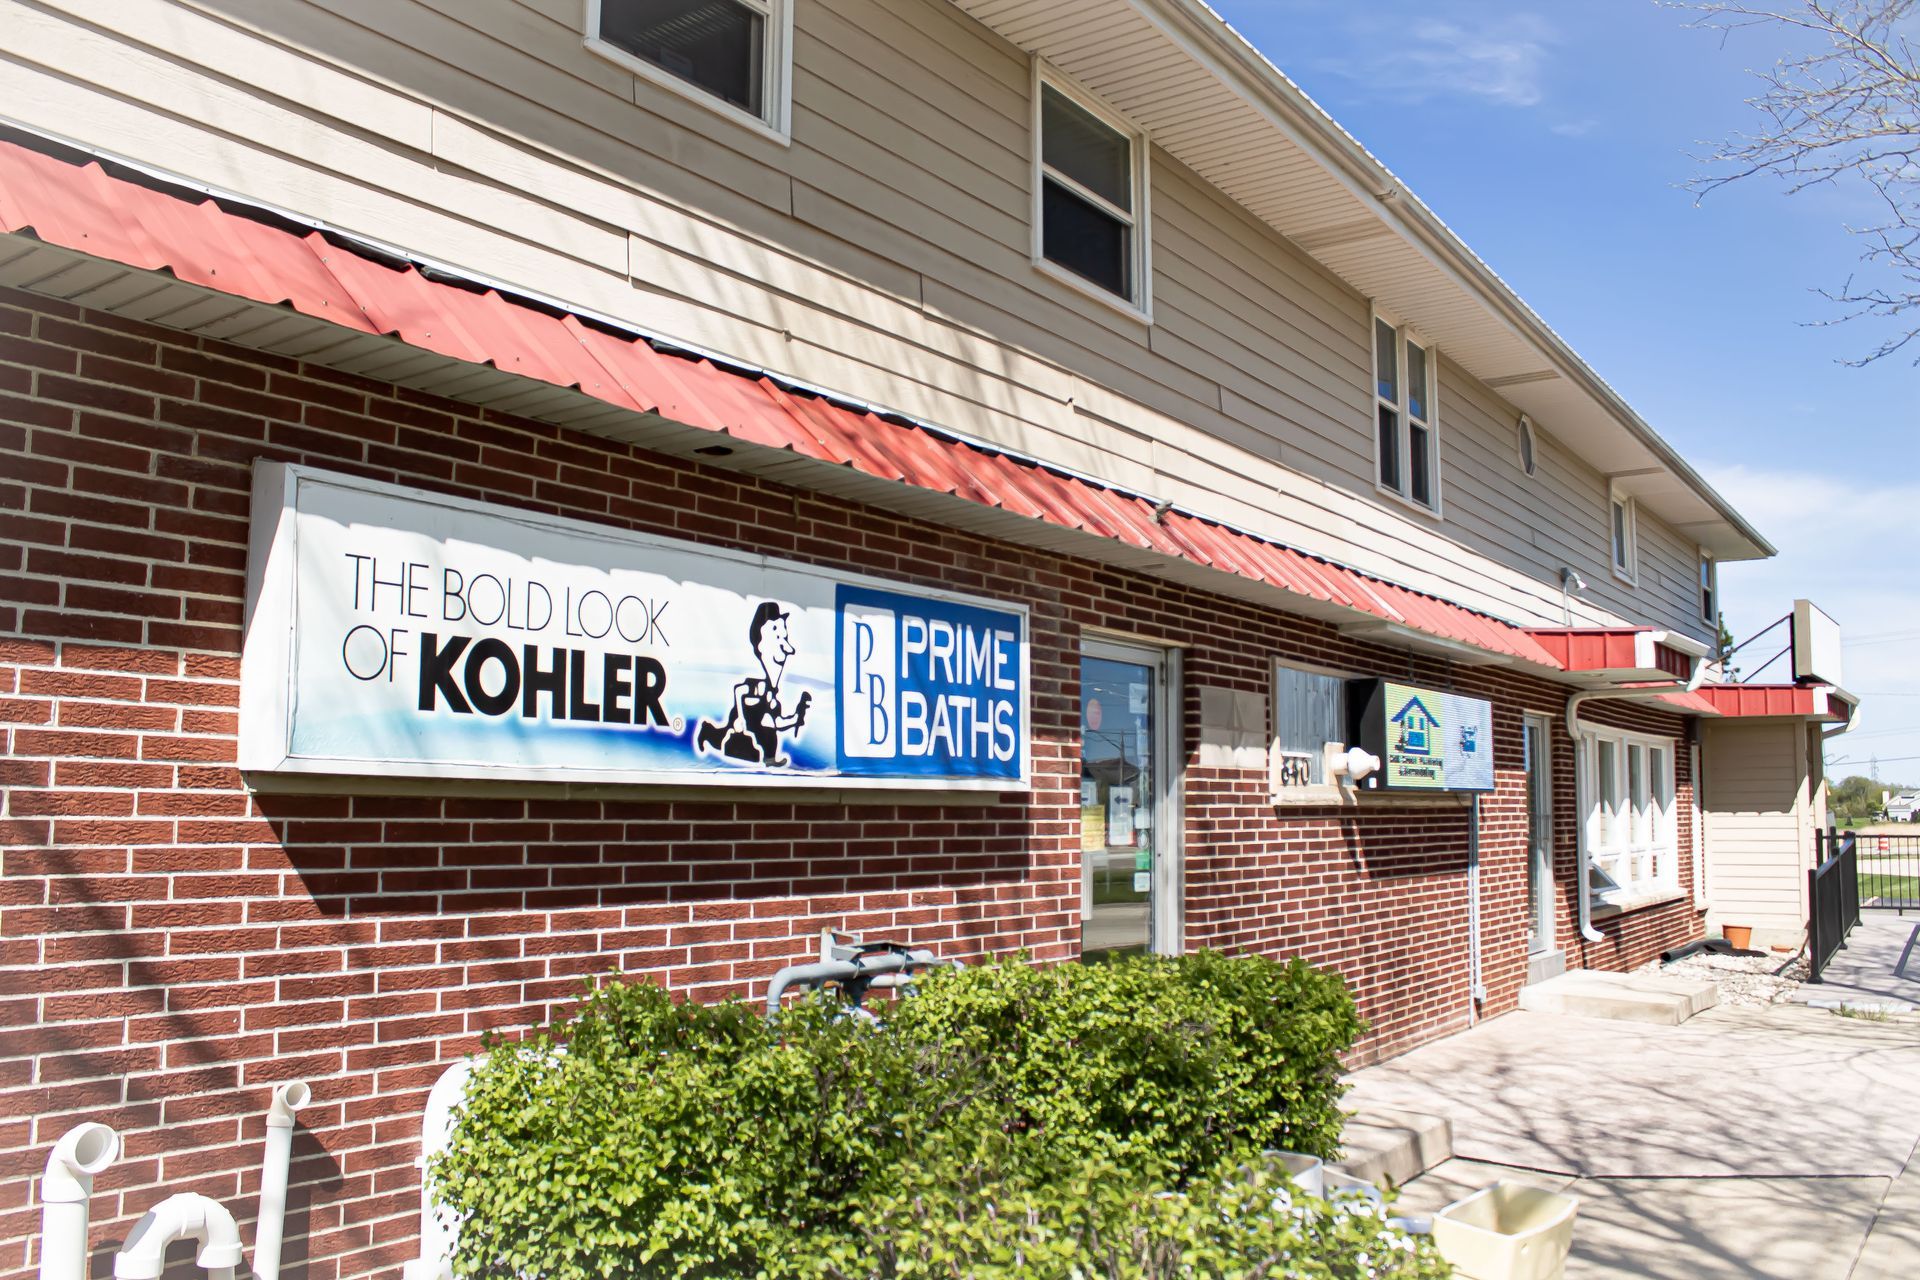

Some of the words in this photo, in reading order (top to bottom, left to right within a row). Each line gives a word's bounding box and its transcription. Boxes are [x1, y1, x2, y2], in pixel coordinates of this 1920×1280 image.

[345, 553, 429, 617] THE
[443, 568, 552, 630] BOLD
[566, 586, 670, 647] LOOK
[343, 624, 408, 683] OF
[418, 631, 670, 727] KOHLER
[902, 615, 1016, 691] PRIME
[901, 691, 1016, 762] BATHS
